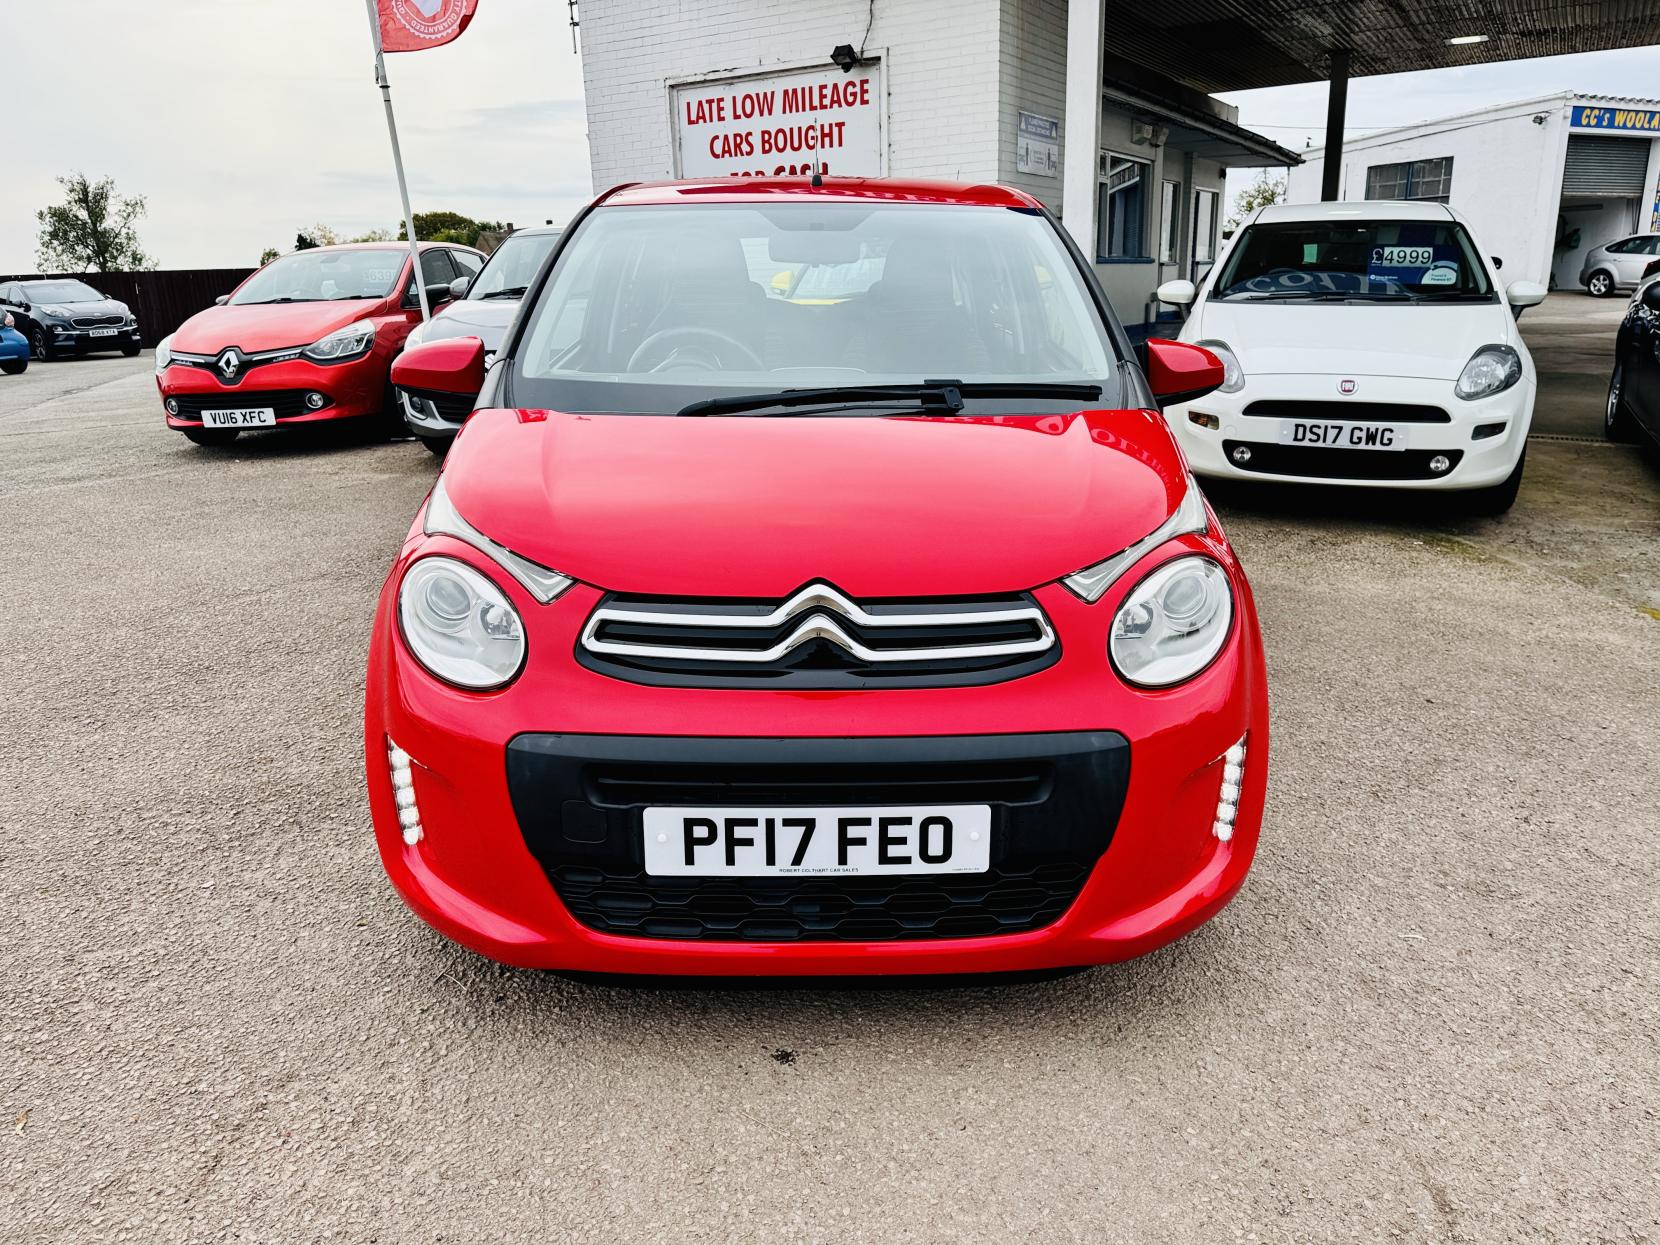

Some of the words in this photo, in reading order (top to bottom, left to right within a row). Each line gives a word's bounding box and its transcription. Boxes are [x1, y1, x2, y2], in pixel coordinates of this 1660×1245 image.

[686, 97, 725, 125] LATE
[732, 91, 775, 120] LOW
[782, 79, 870, 114] MILEAGE
[709, 132, 754, 159] CARS
[761, 121, 846, 155] BOUGHT
[1371, 248, 1431, 265] £4999
[210, 412, 238, 425] VU16
[240, 411, 267, 423] XFC
[1293, 423, 1343, 444] DS17
[1349, 426, 1394, 447] GWG
[683, 817, 817, 866] PF17
[837, 815, 953, 865] FEO
